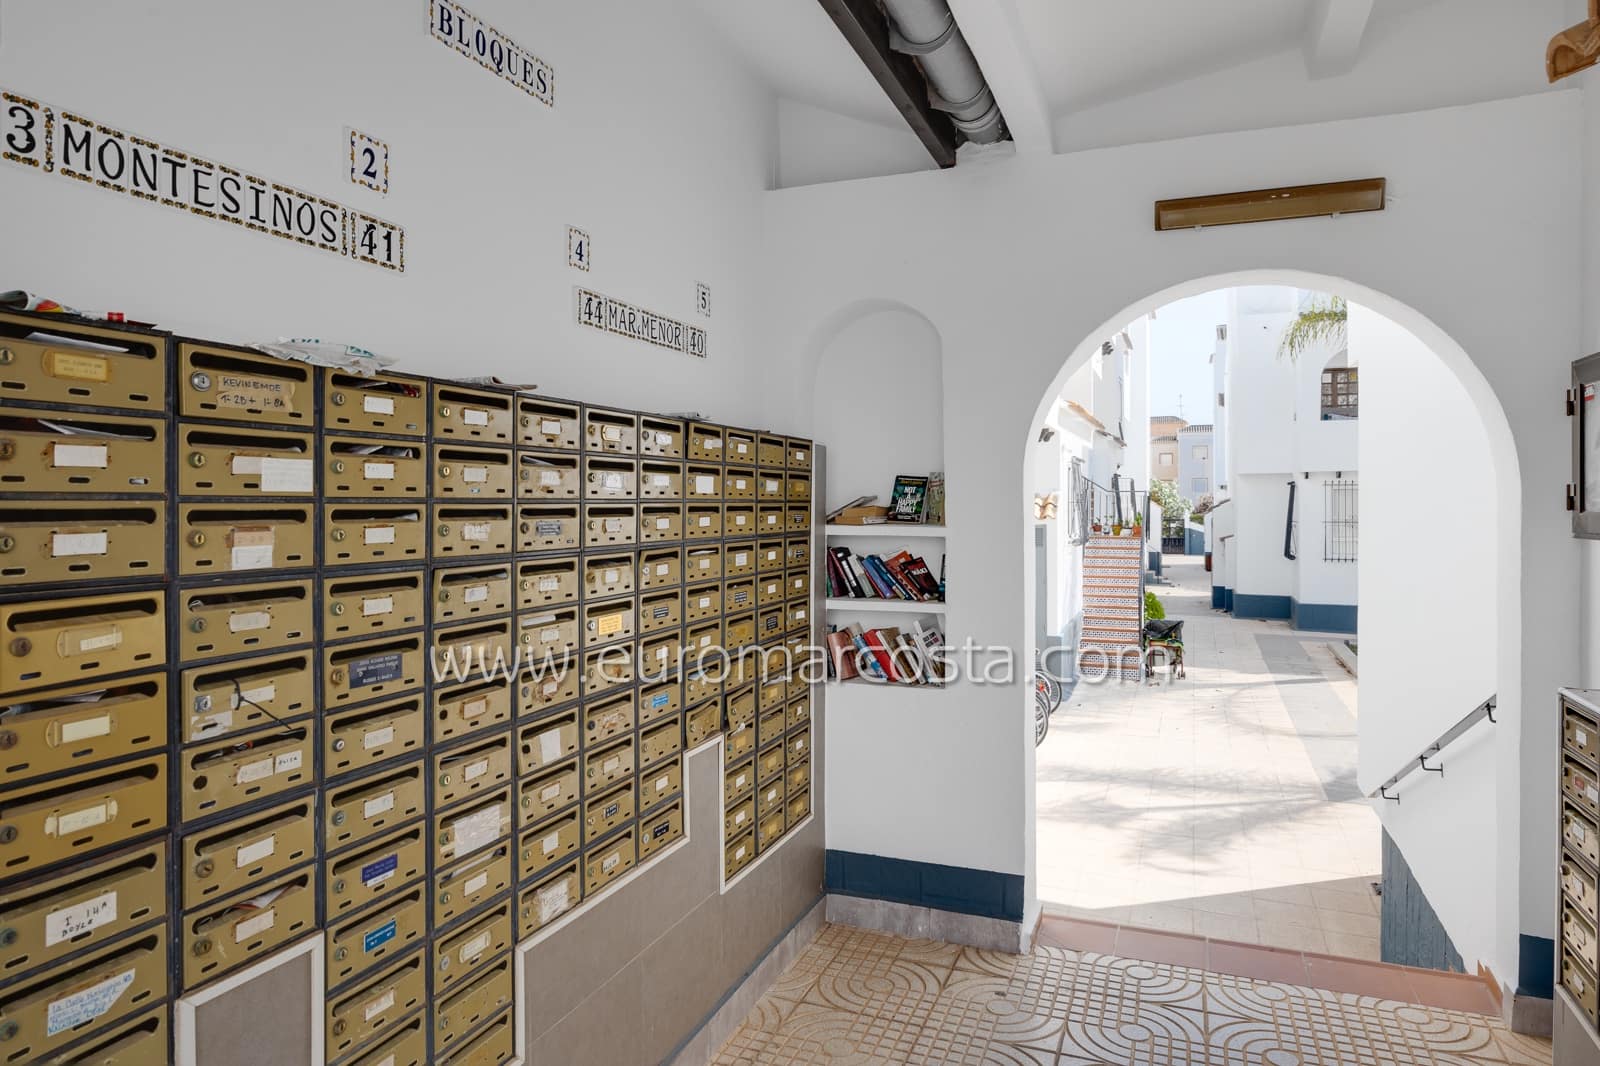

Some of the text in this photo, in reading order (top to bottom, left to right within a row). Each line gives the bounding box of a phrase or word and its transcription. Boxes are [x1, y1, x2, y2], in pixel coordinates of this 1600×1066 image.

[438, 4, 548, 95] BLOQUES
[362, 147, 378, 180] 2
[6, 105, 393, 263] 3 MONTESINOS 41
[575, 240, 584, 262] 4
[701, 291, 707, 310] 5
[584, 297, 603, 325] 44
[690, 332, 704, 354] 40
[904, 486, 917, 494] NOT
